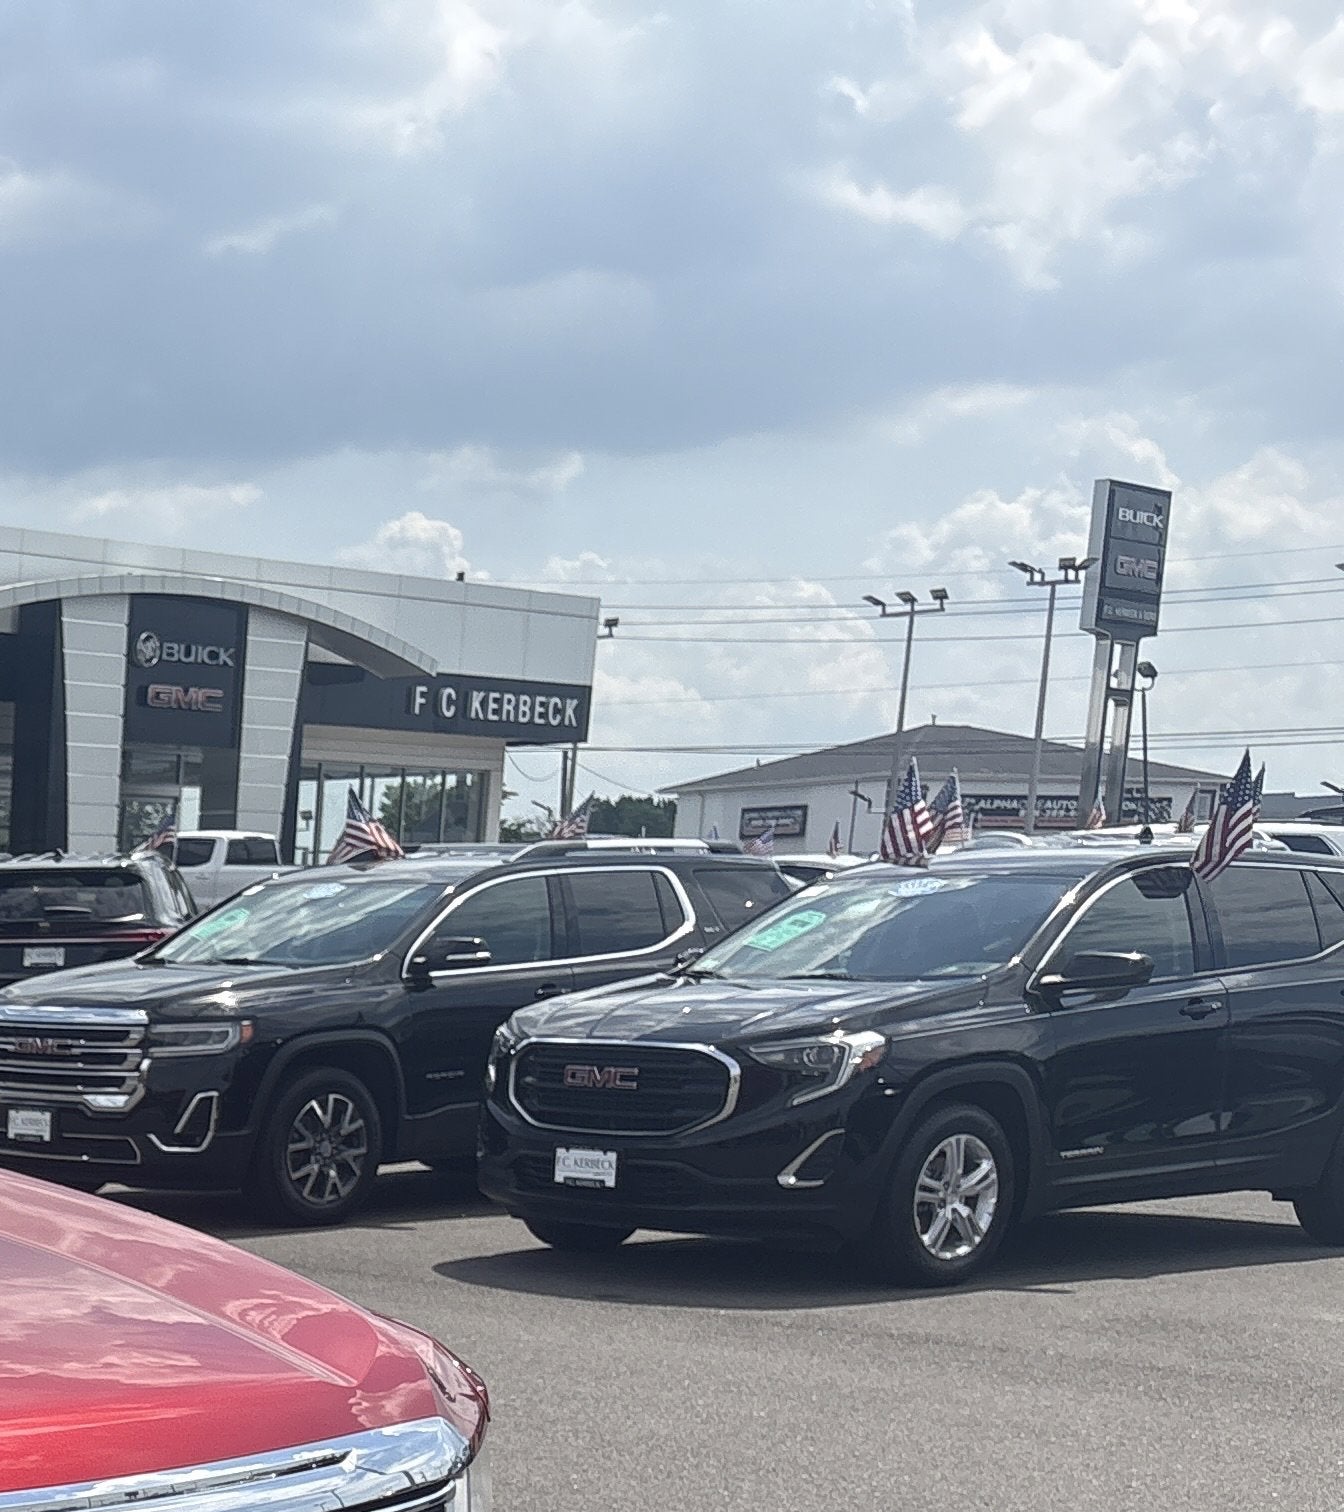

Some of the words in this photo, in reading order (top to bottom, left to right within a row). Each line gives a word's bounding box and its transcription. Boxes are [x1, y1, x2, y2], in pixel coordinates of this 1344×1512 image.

[1118, 507, 1164, 529] BUICK
[1116, 555, 1159, 579] GMC
[161, 642, 236, 667] BUICK
[147, 684, 224, 712] GMC
[414, 686, 428, 715] F
[440, 687, 457, 718] C
[470, 690, 579, 728] KERBECK
[14, 1037, 76, 1055] GMC
[564, 1064, 639, 1089] GMC
